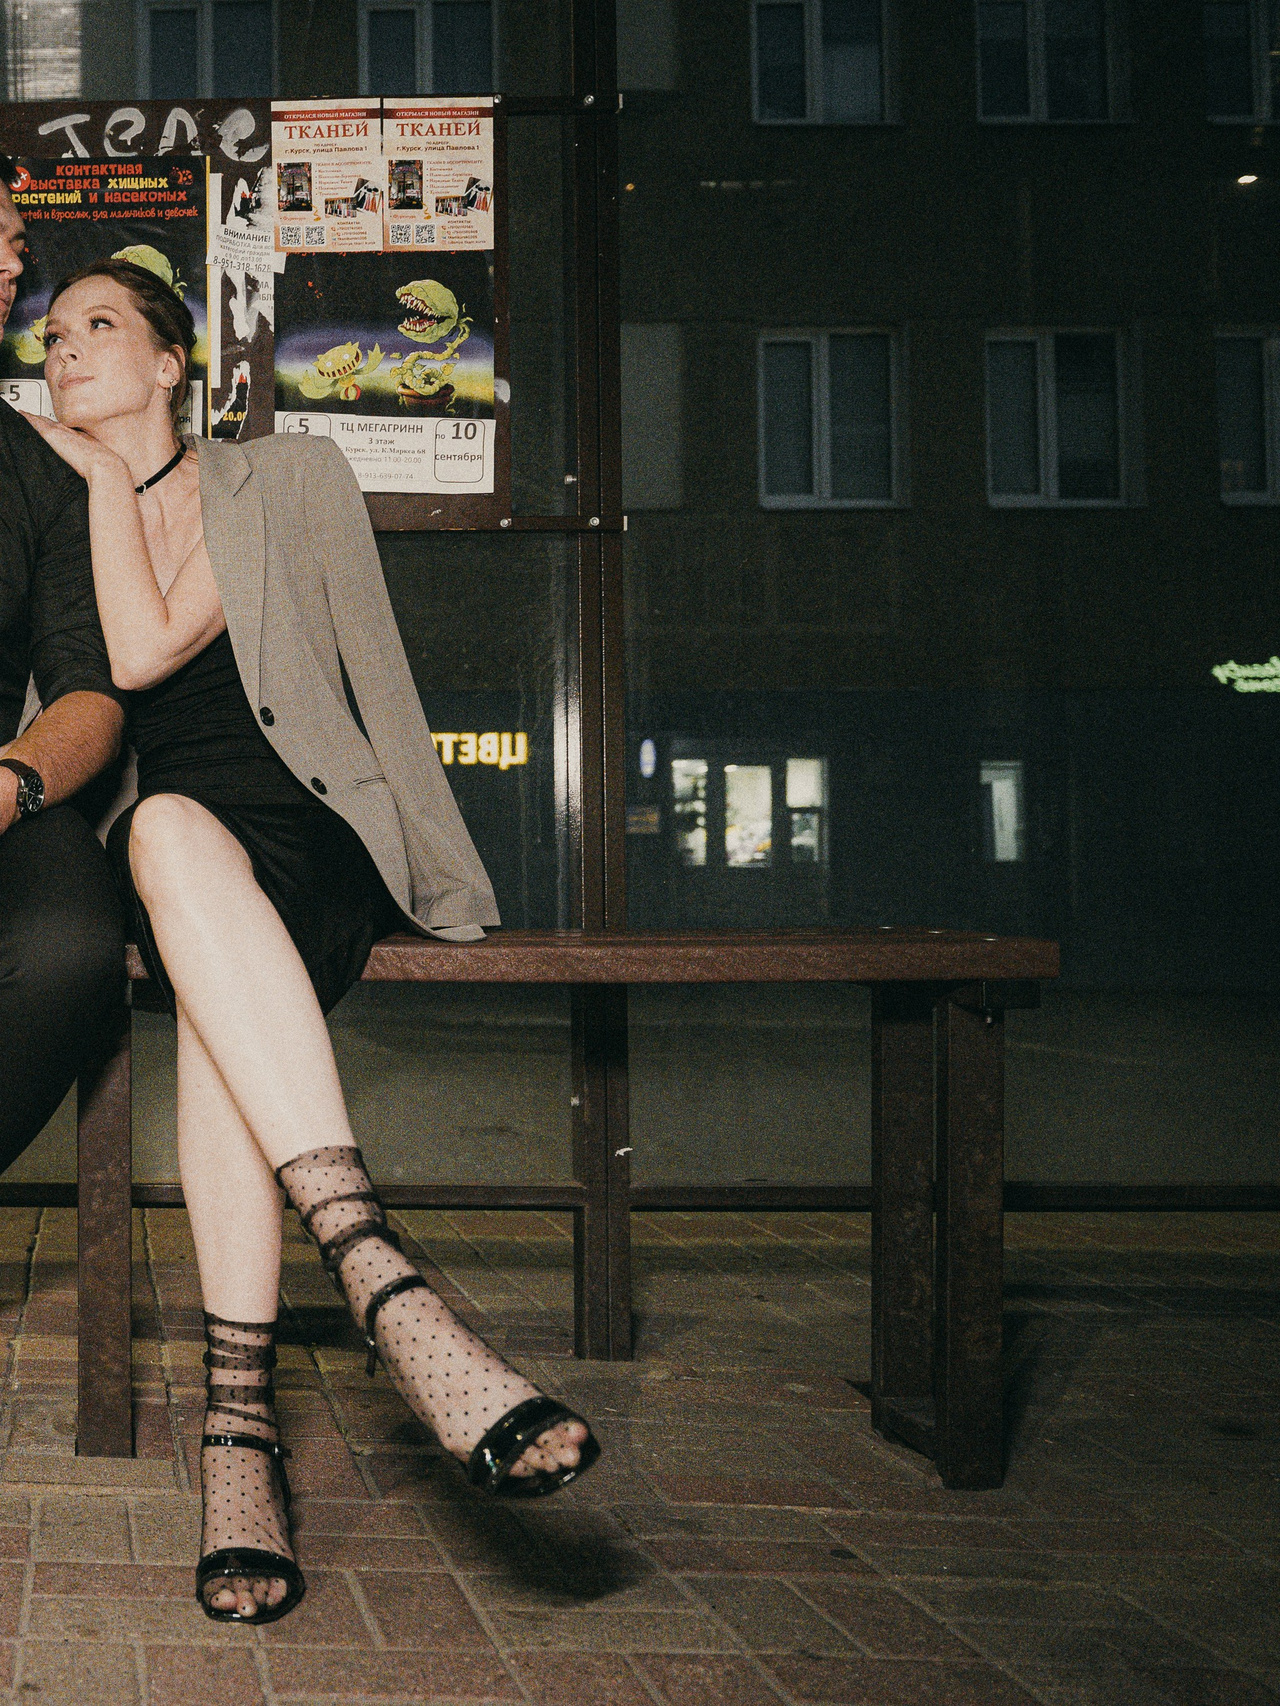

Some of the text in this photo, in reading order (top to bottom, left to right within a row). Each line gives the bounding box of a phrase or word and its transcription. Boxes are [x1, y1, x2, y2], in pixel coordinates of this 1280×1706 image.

[284, 120, 369, 139] ТКАНЕЙ
[395, 119, 481, 137] ТКАНЕЙ
[424, 145, 445, 153] улица
[56, 163, 143, 176] контактная
[30, 177, 100, 190] выставка
[107, 176, 168, 190] хищных
[89, 191, 97, 203] и
[104, 189, 187, 203] насекомых
[92, 209, 108, 221] для
[109, 207, 156, 220] мальчиков
[165, 205, 199, 219] девочек
[216, 234, 251, 248] ПОДРАБОТКА
[223, 227, 271, 243] ВНИМАНИЕ!
[213, 255, 272, 273] 8-951-318-1628
[9, 384, 21, 401] 5
[298, 418, 310, 434] 5
[340, 421, 423, 434] ТЦ МЕГАГРИНН
[451, 422, 478, 440] 10
[368, 437, 373, 445] 3
[417, 447, 426, 455] 68
[434, 451, 483, 463] сентября
